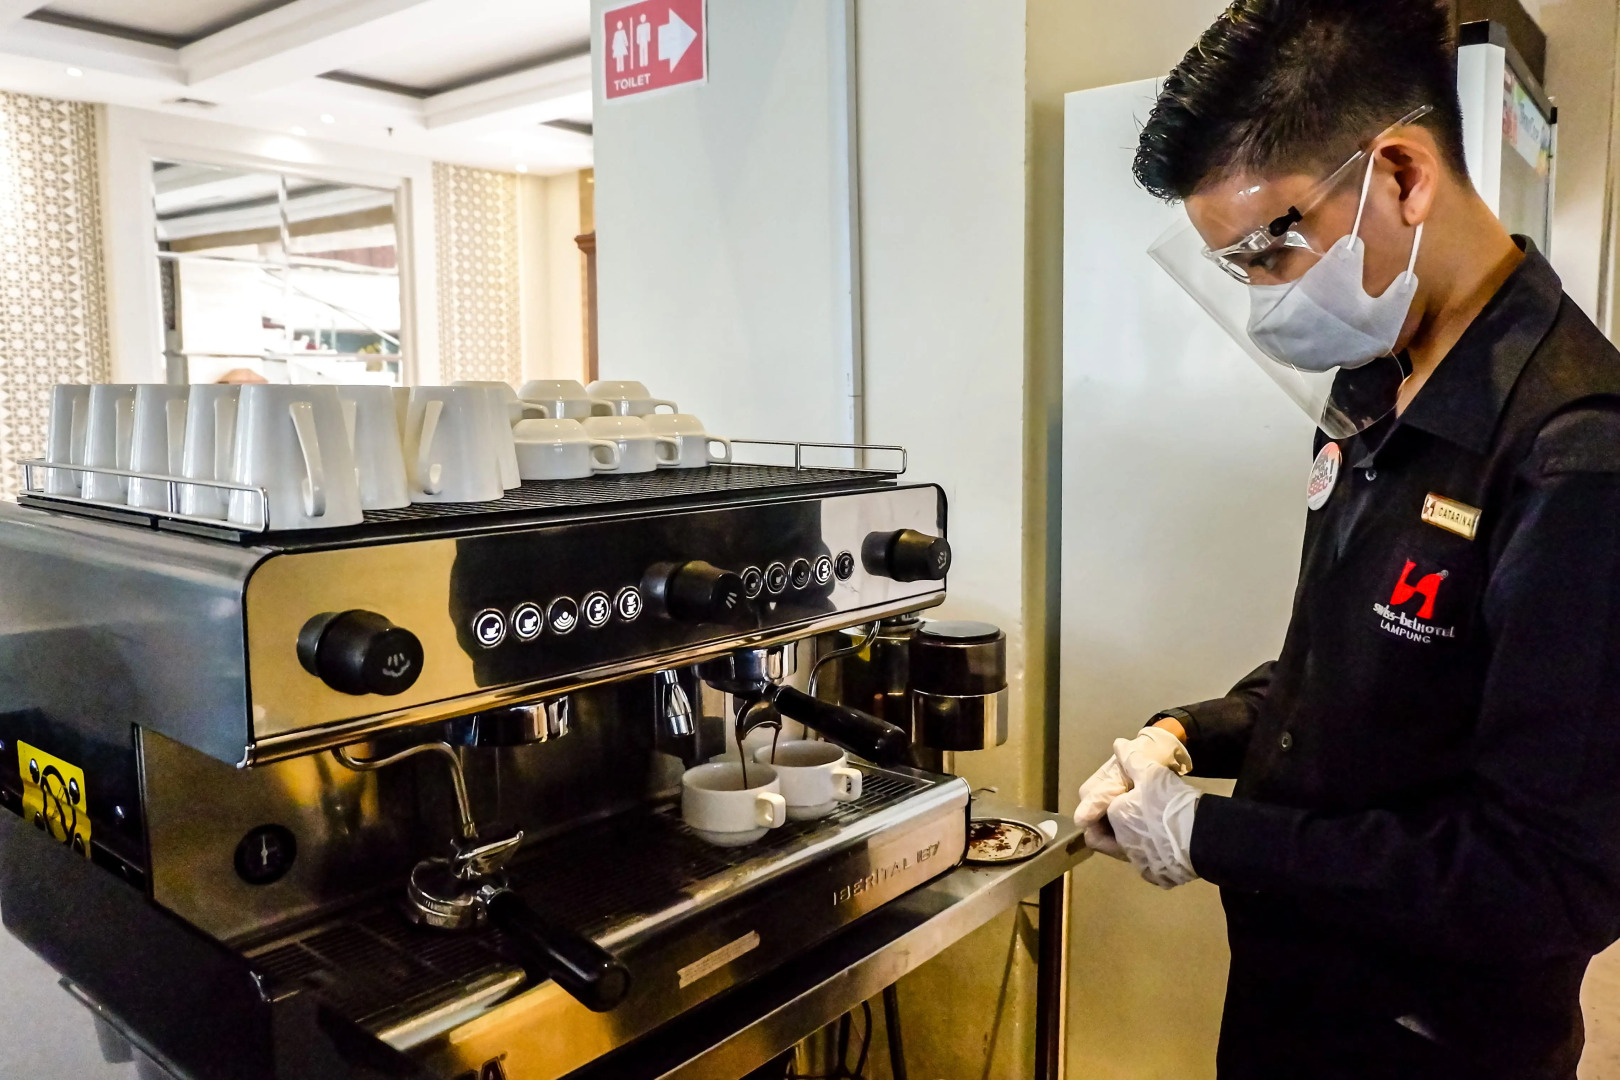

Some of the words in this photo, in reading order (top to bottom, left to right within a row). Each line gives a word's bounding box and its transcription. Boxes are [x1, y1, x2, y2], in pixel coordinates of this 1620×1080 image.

[614, 73, 651, 91] TOILET
[1380, 619, 1431, 643] LAMPUNG
[833, 858, 911, 906] IBERITAL
